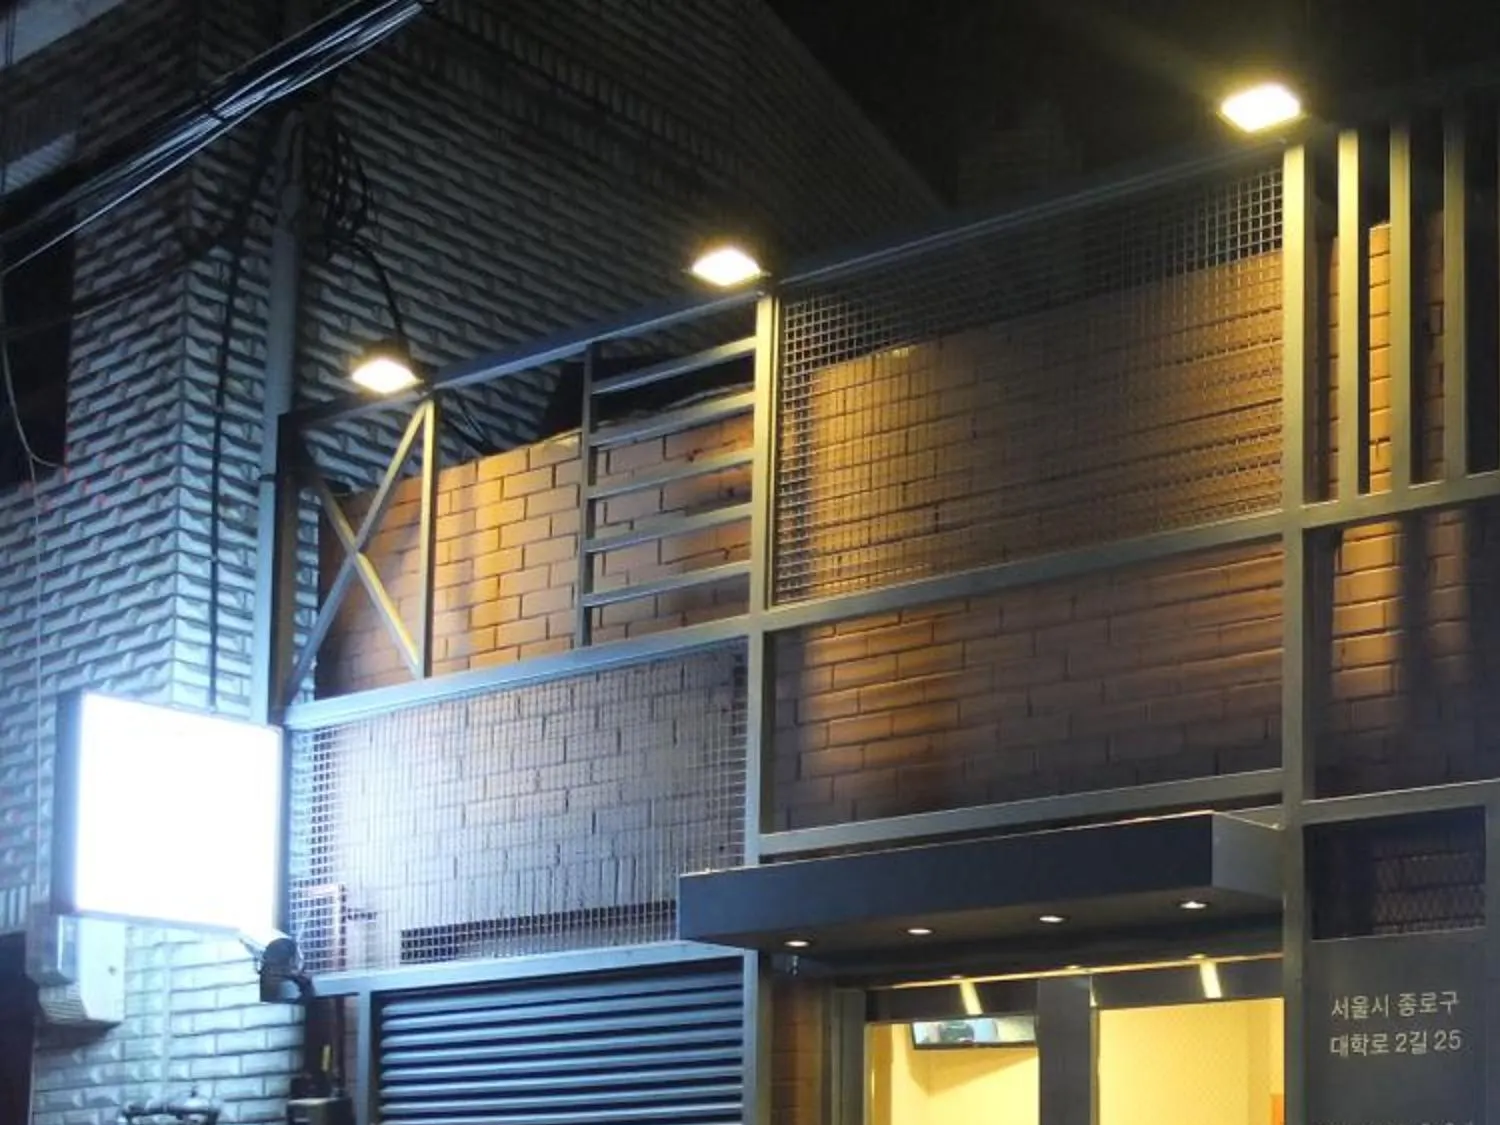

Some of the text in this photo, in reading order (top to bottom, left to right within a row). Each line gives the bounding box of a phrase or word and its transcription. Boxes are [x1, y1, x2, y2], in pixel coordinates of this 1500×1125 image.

[1331, 991, 1460, 1020] 서울시 종로구
[1330, 1030, 1462, 1058] 대학로 2길 25
